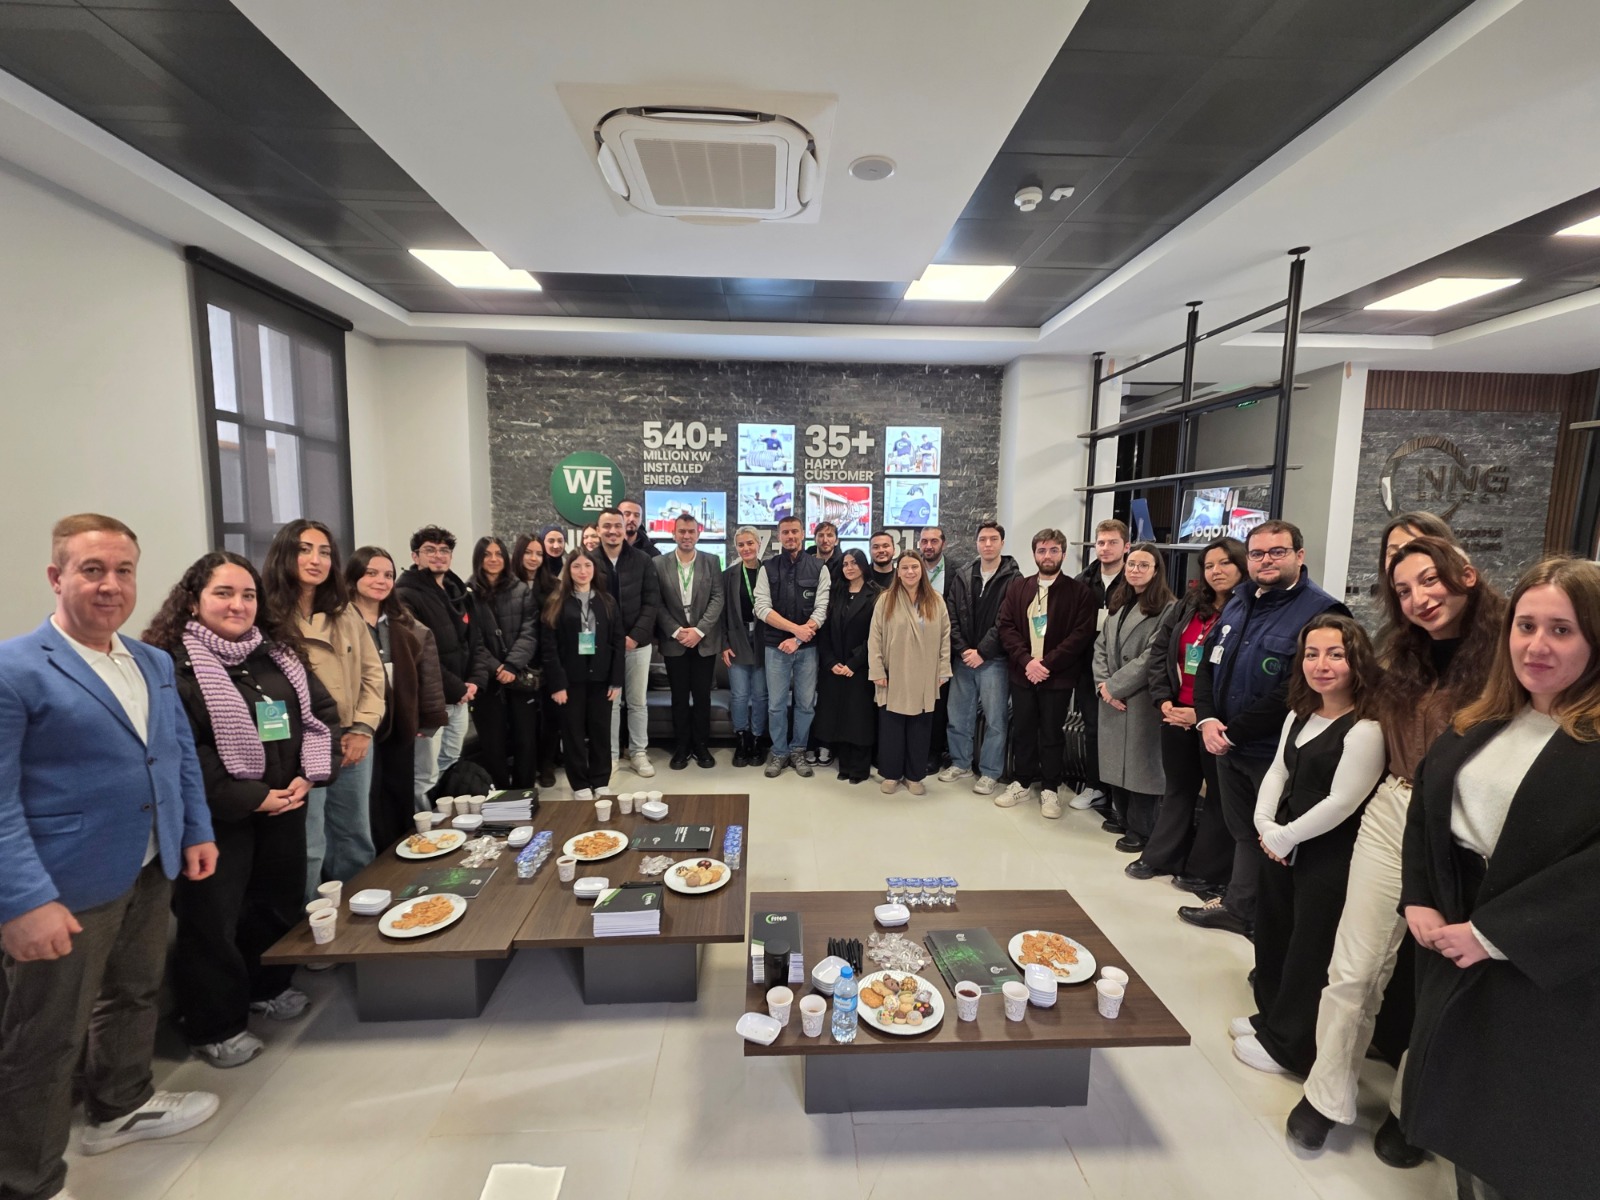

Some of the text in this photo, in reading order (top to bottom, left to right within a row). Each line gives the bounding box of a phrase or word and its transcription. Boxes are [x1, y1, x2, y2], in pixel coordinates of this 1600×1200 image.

[643, 421, 728, 450] 540+
[804, 424, 875, 458] 35+
[643, 451, 711, 462] MILLION KW
[643, 462, 704, 474] INSTALLED
[804, 459, 846, 469] HAPPY
[563, 469, 612, 494] WE
[643, 474, 689, 486] ENERGY
[804, 470, 874, 481] CUSTOMER
[583, 495, 613, 508] ARE
